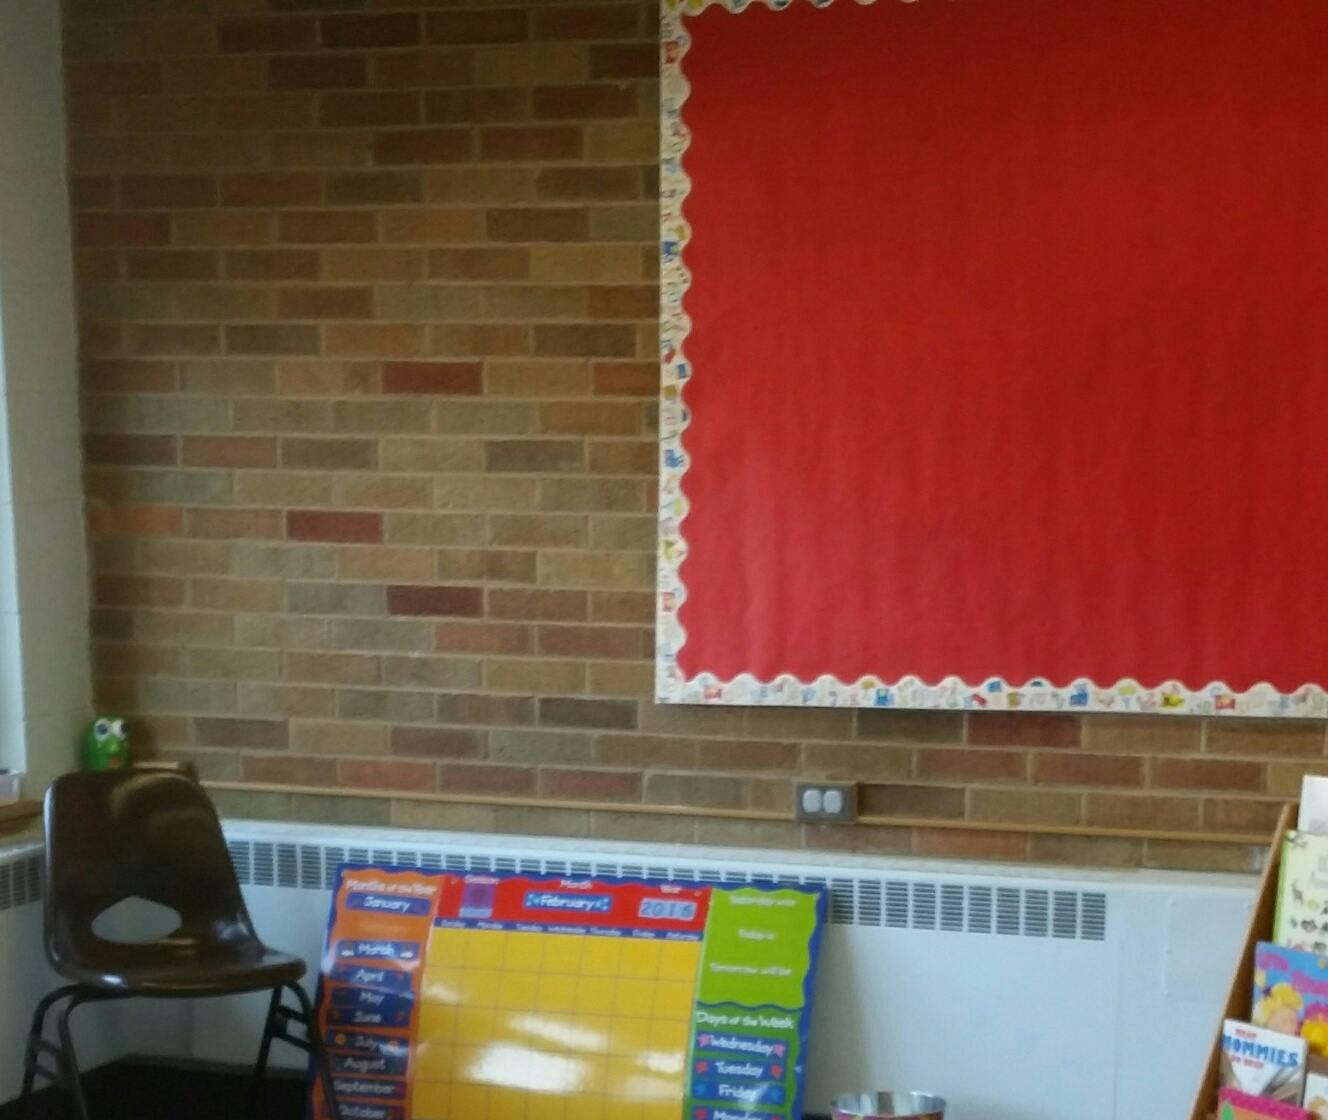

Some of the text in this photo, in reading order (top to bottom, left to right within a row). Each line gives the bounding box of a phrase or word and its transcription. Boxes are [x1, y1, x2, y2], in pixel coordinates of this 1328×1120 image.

[541, 894, 594, 912] February
[640, 901, 693, 919] 2016
[714, 1061, 763, 1079] Tuesday
